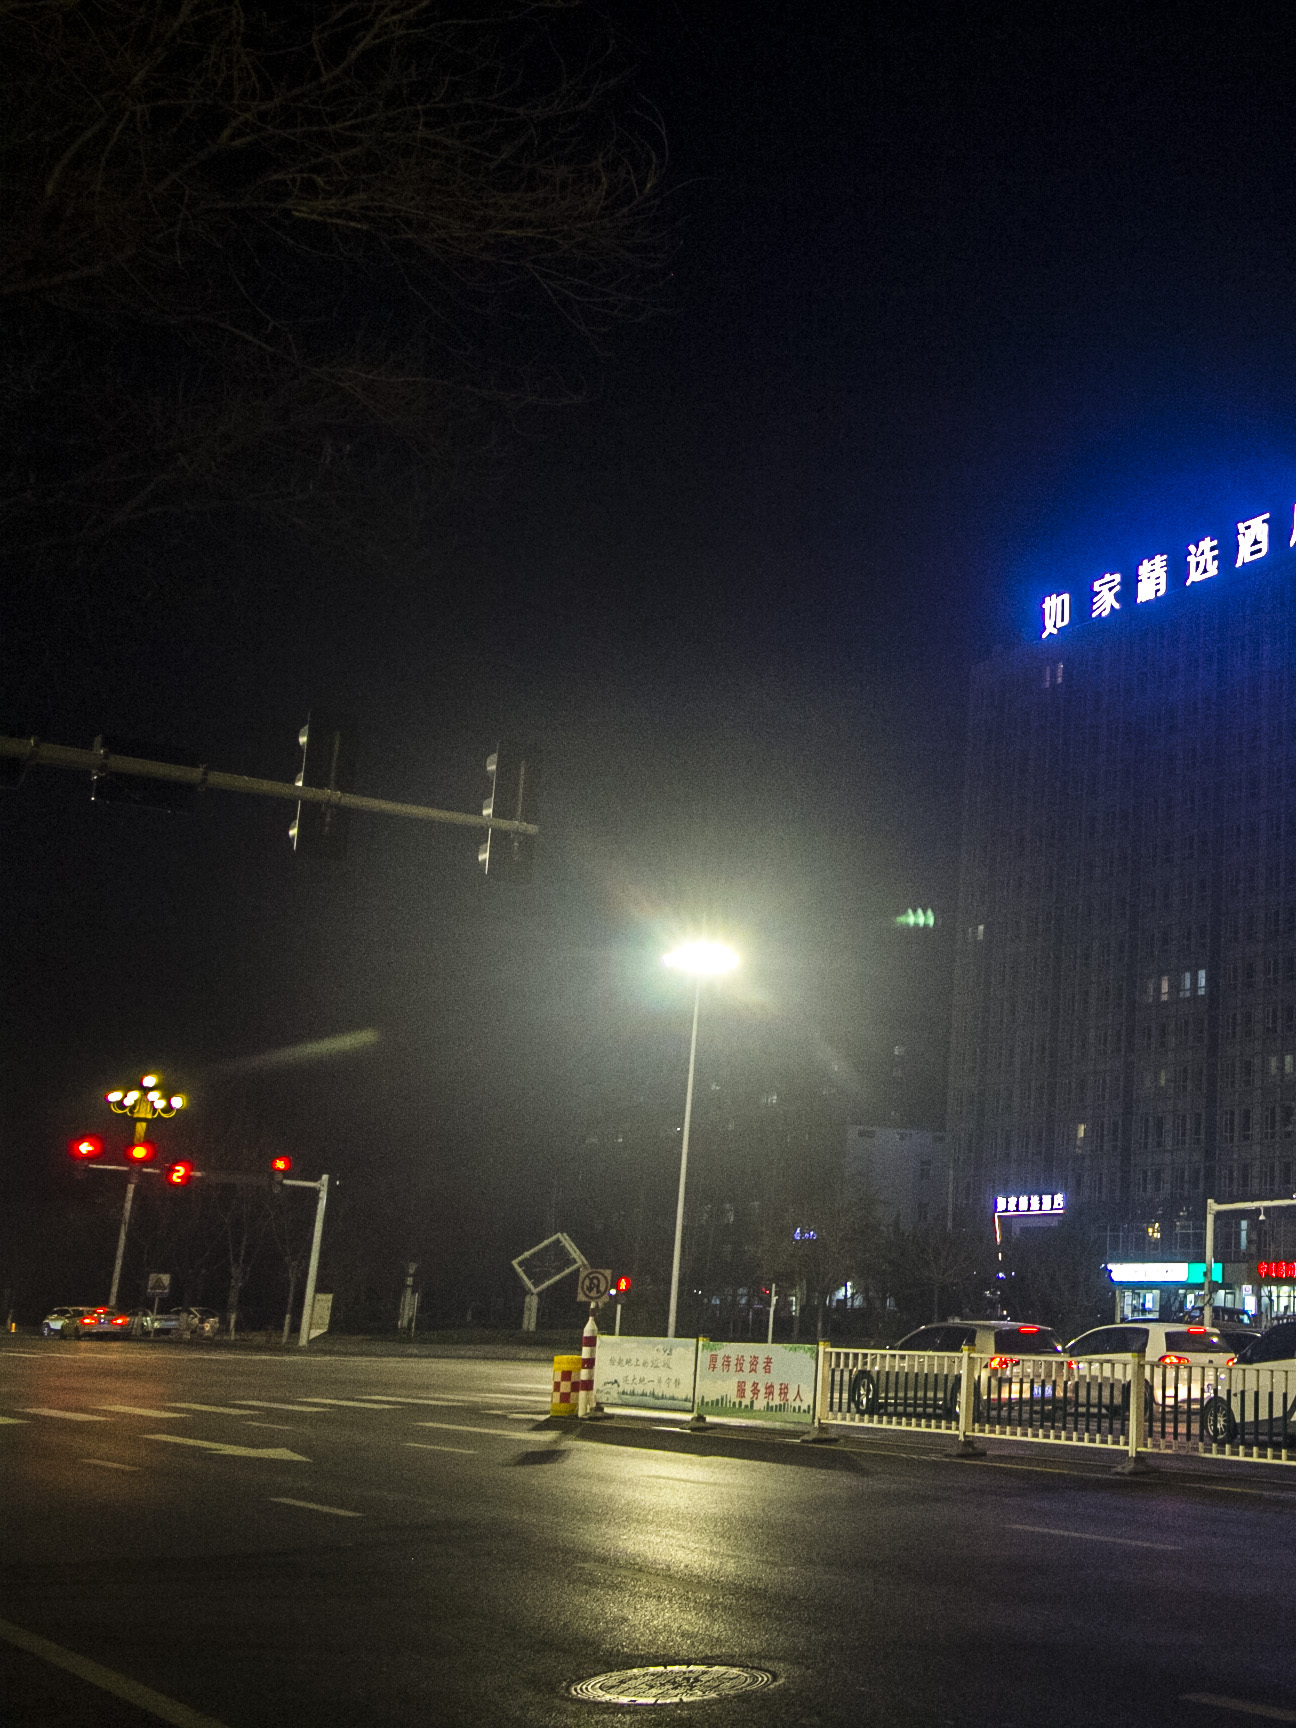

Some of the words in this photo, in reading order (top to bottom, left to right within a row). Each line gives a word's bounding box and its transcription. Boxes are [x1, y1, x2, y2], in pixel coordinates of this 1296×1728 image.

[172, 1165, 185, 1183] 2
[707, 1353, 774, 1375] 厚待投资者
[735, 1380, 804, 1403] 服务纳税人
